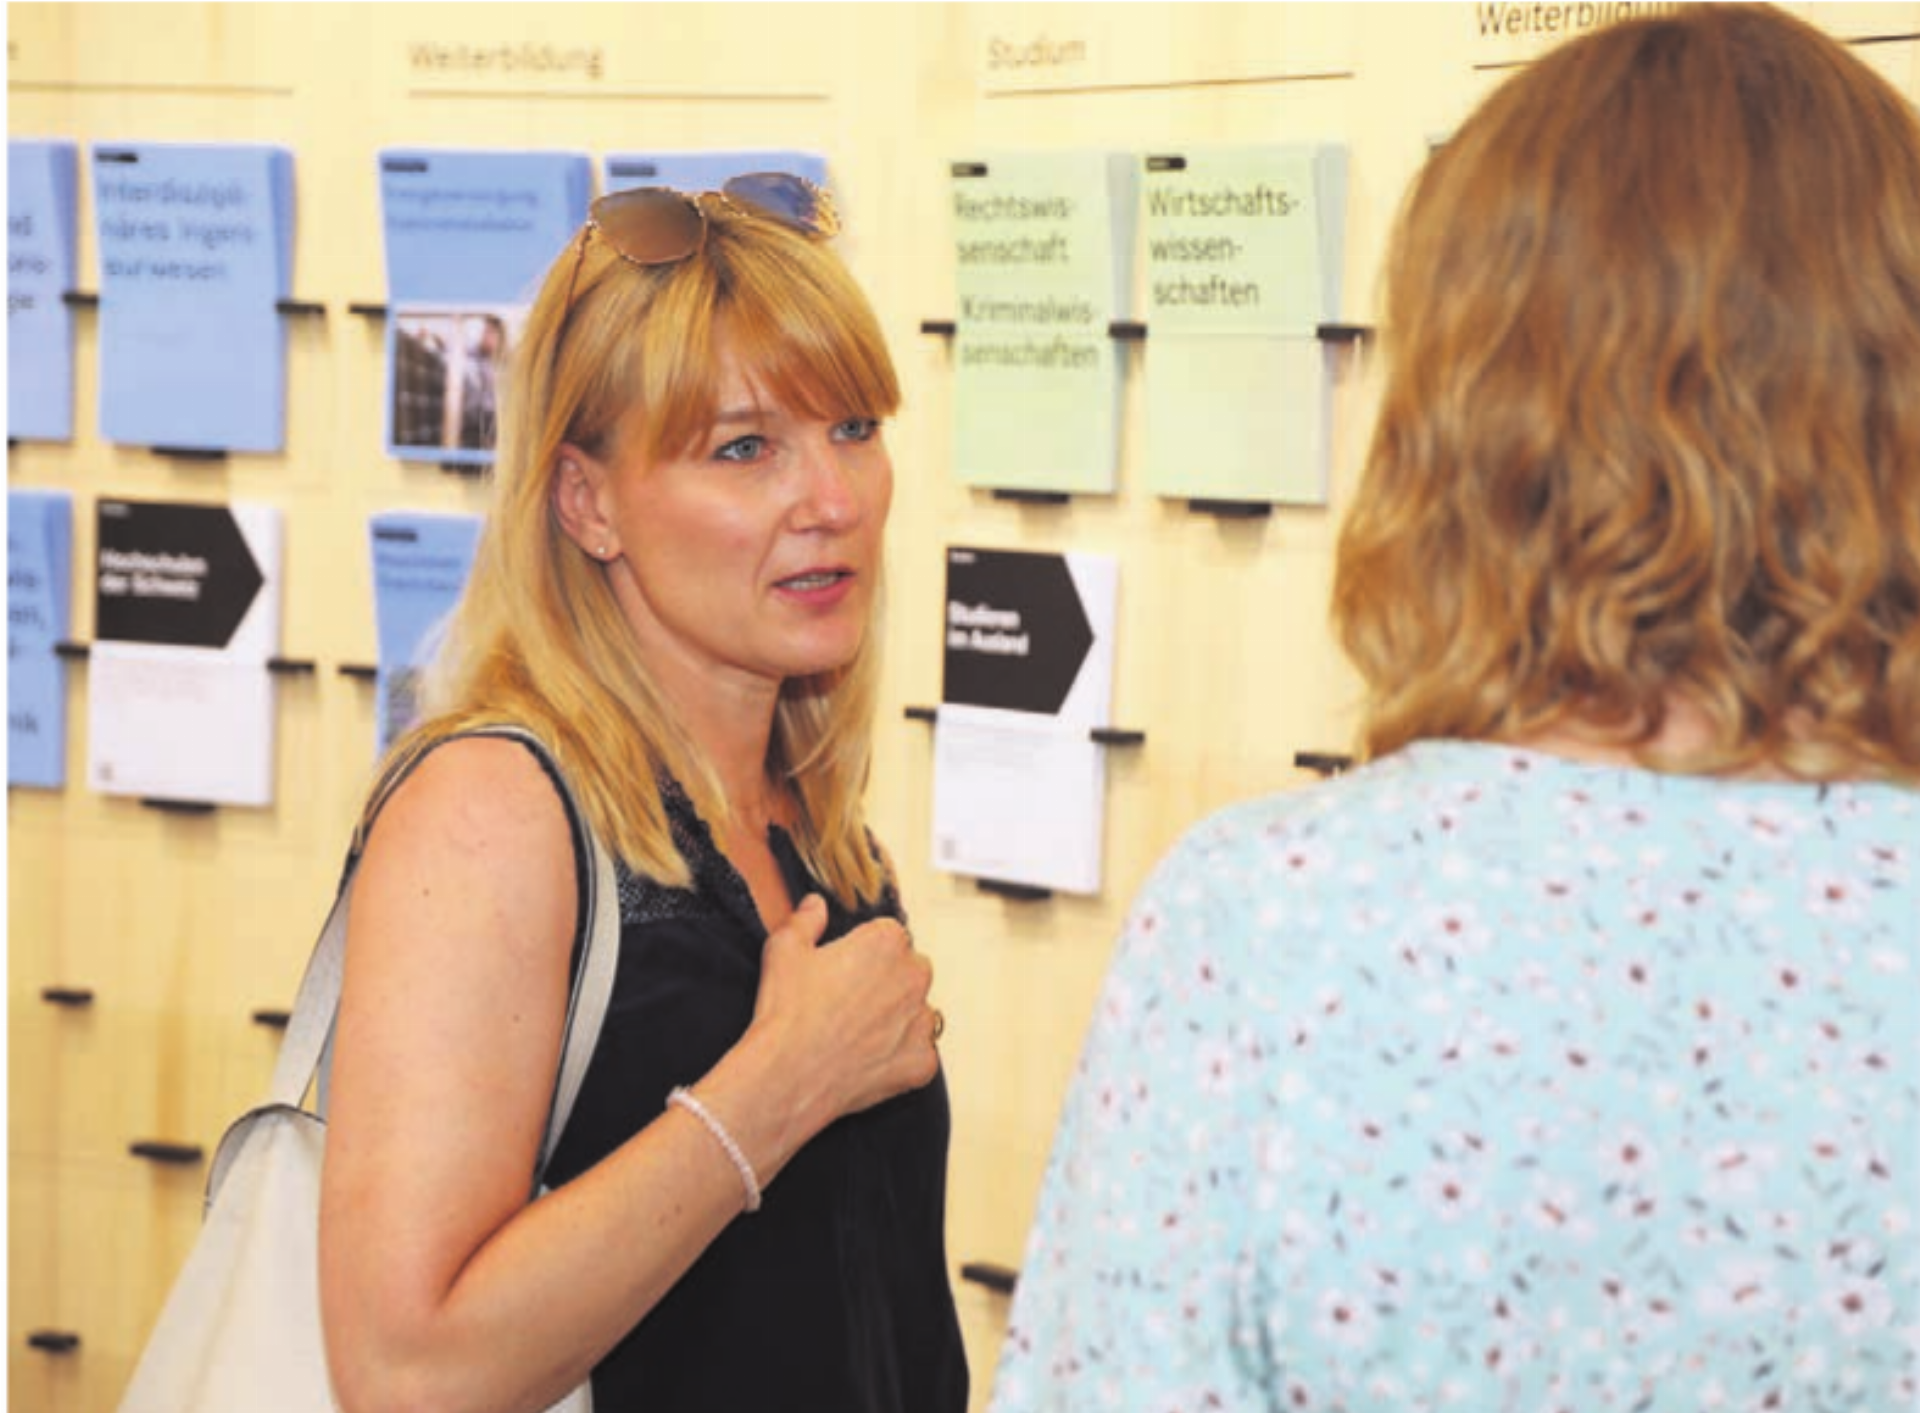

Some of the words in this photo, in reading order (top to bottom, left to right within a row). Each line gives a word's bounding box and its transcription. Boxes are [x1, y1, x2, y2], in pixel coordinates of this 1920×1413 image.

[408, 41, 604, 79] Weiterbildung
[987, 34, 1086, 70] Studium
[1148, 184, 1300, 217] Wirtschafts-
[956, 233, 1069, 264] senschaft
[1150, 234, 1243, 262] wissen-
[1153, 278, 1260, 306] schaften
[962, 336, 1099, 370] senschaften
